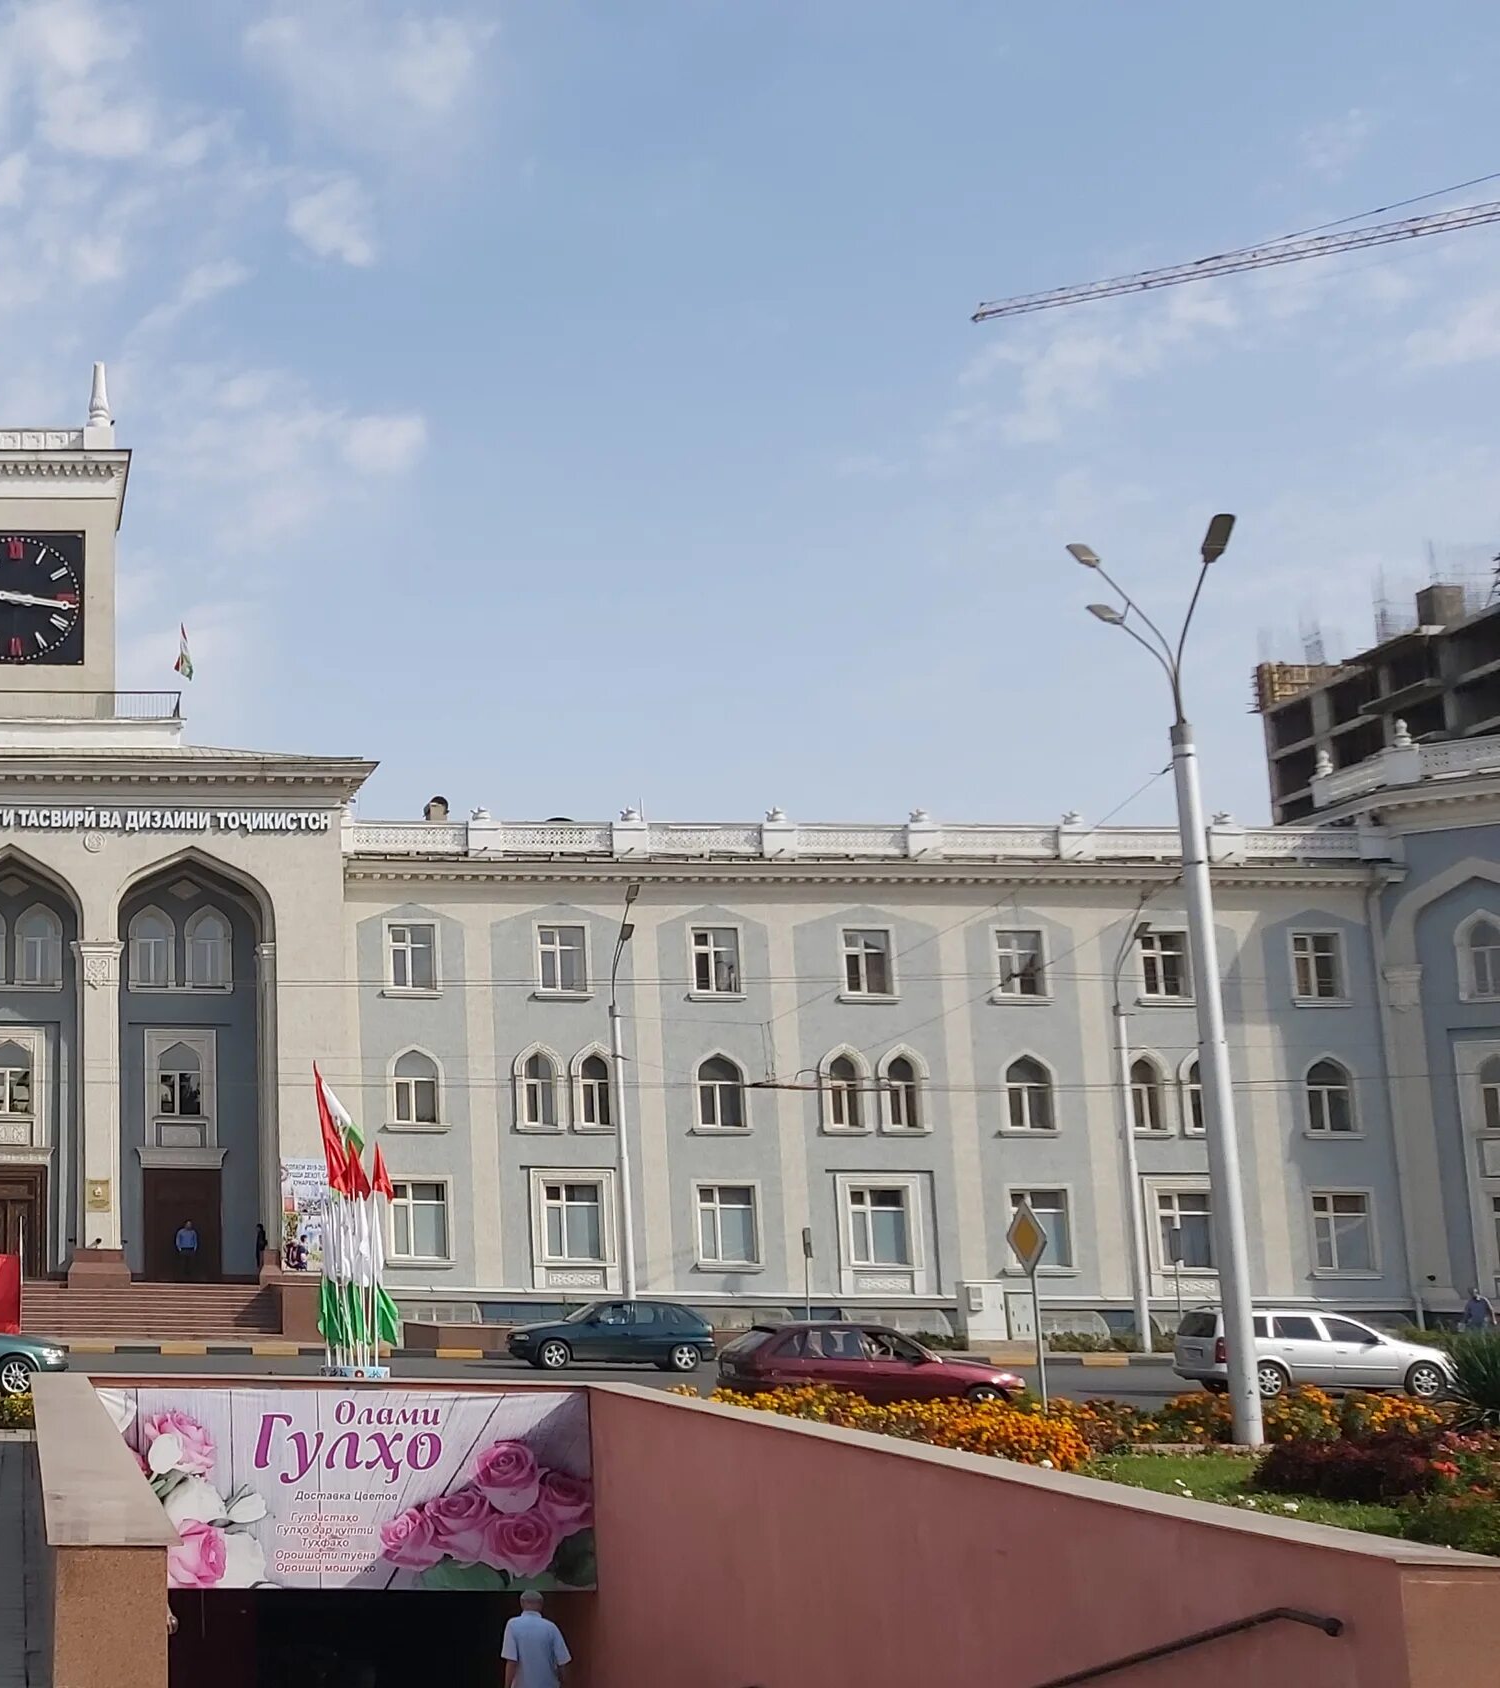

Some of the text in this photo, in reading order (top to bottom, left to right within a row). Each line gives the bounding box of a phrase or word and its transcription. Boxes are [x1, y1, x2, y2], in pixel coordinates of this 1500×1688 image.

[50, 566, 69, 581] II
[99, 809, 122, 829] ВА
[335, 1400, 441, 1426] Олами
[254, 1413, 442, 1484] Гулҳо
[295, 1490, 398, 1503] Доставка Цветов
